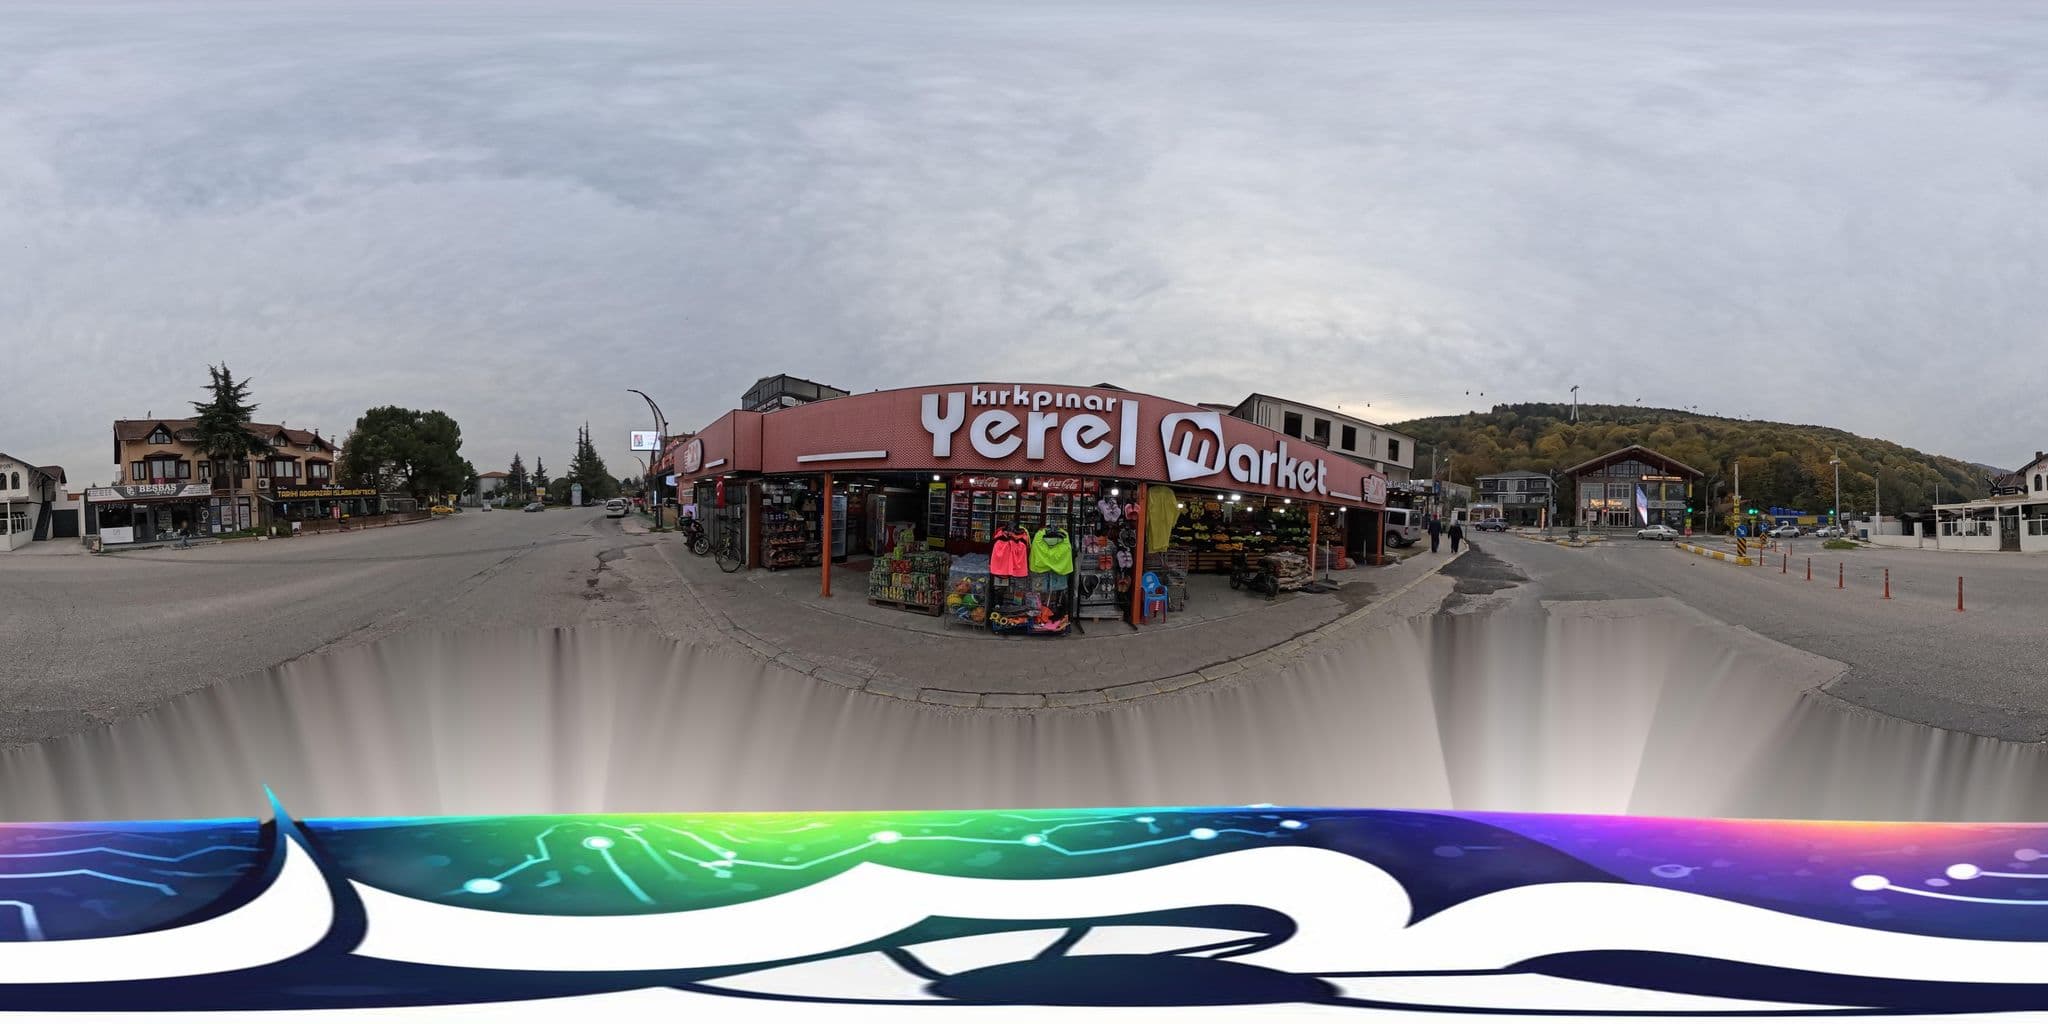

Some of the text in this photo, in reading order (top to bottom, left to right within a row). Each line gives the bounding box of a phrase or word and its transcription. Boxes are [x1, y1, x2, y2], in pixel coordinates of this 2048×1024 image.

[972, 384, 1116, 412] kırkpınar
[921, 391, 1138, 466] Yerel
[1048, 477, 1079, 490] Coca-Cola
